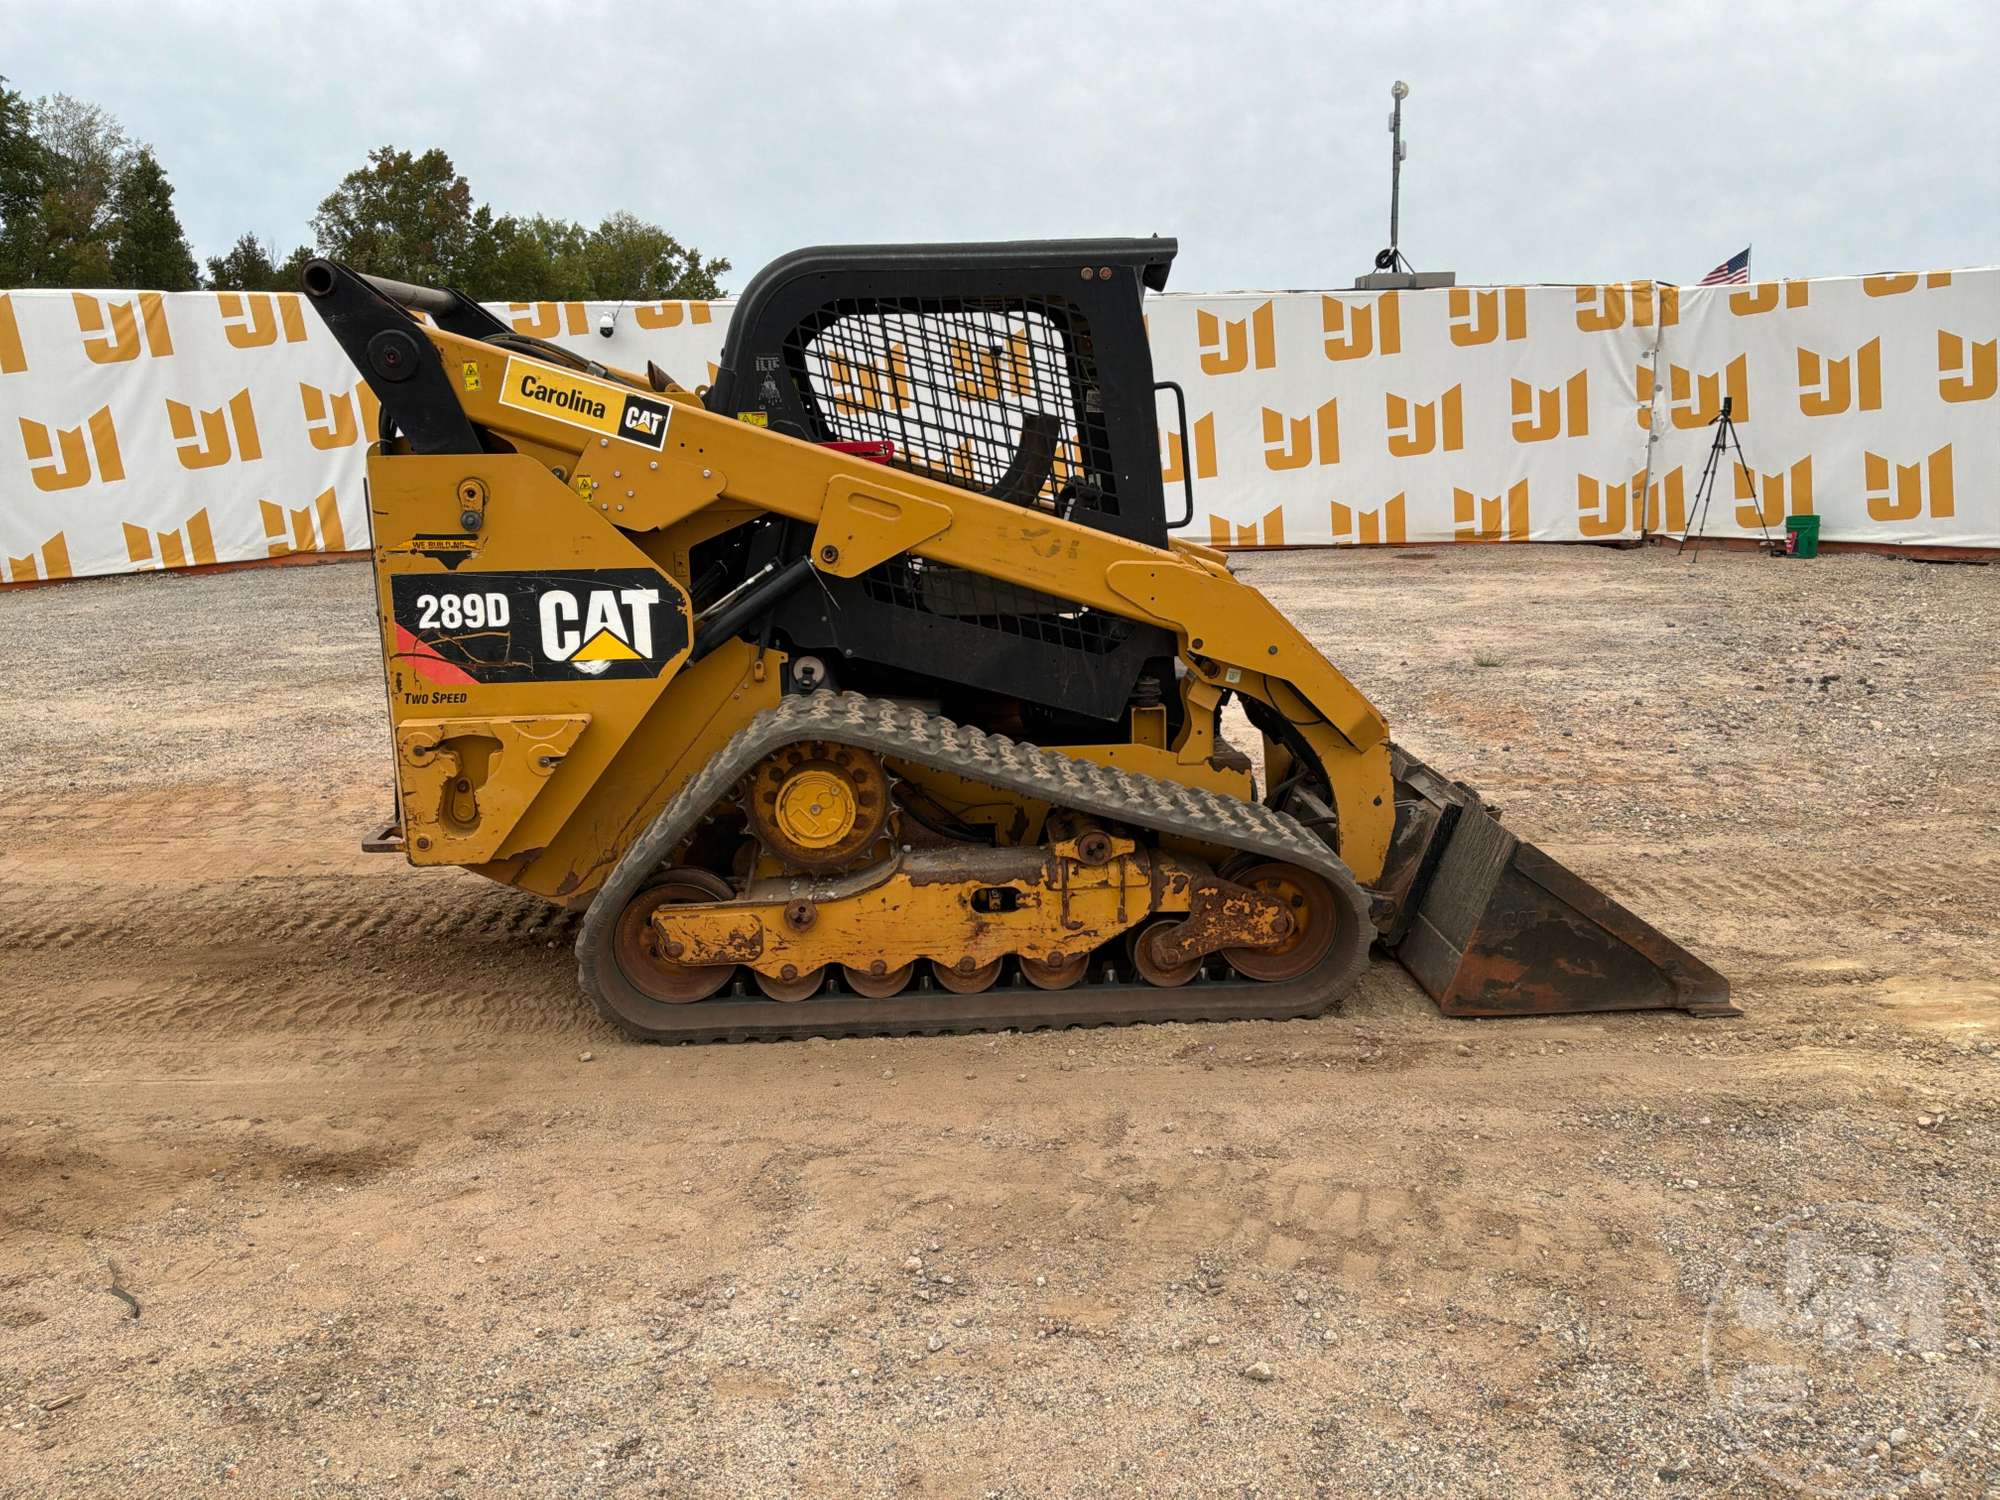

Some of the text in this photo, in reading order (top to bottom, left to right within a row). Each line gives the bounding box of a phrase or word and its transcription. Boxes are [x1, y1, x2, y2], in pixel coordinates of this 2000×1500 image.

[521, 375, 664, 435] Carolina CAT
[416, 589, 659, 662] 289D CAT
[404, 691, 467, 705] TWO SPEED
